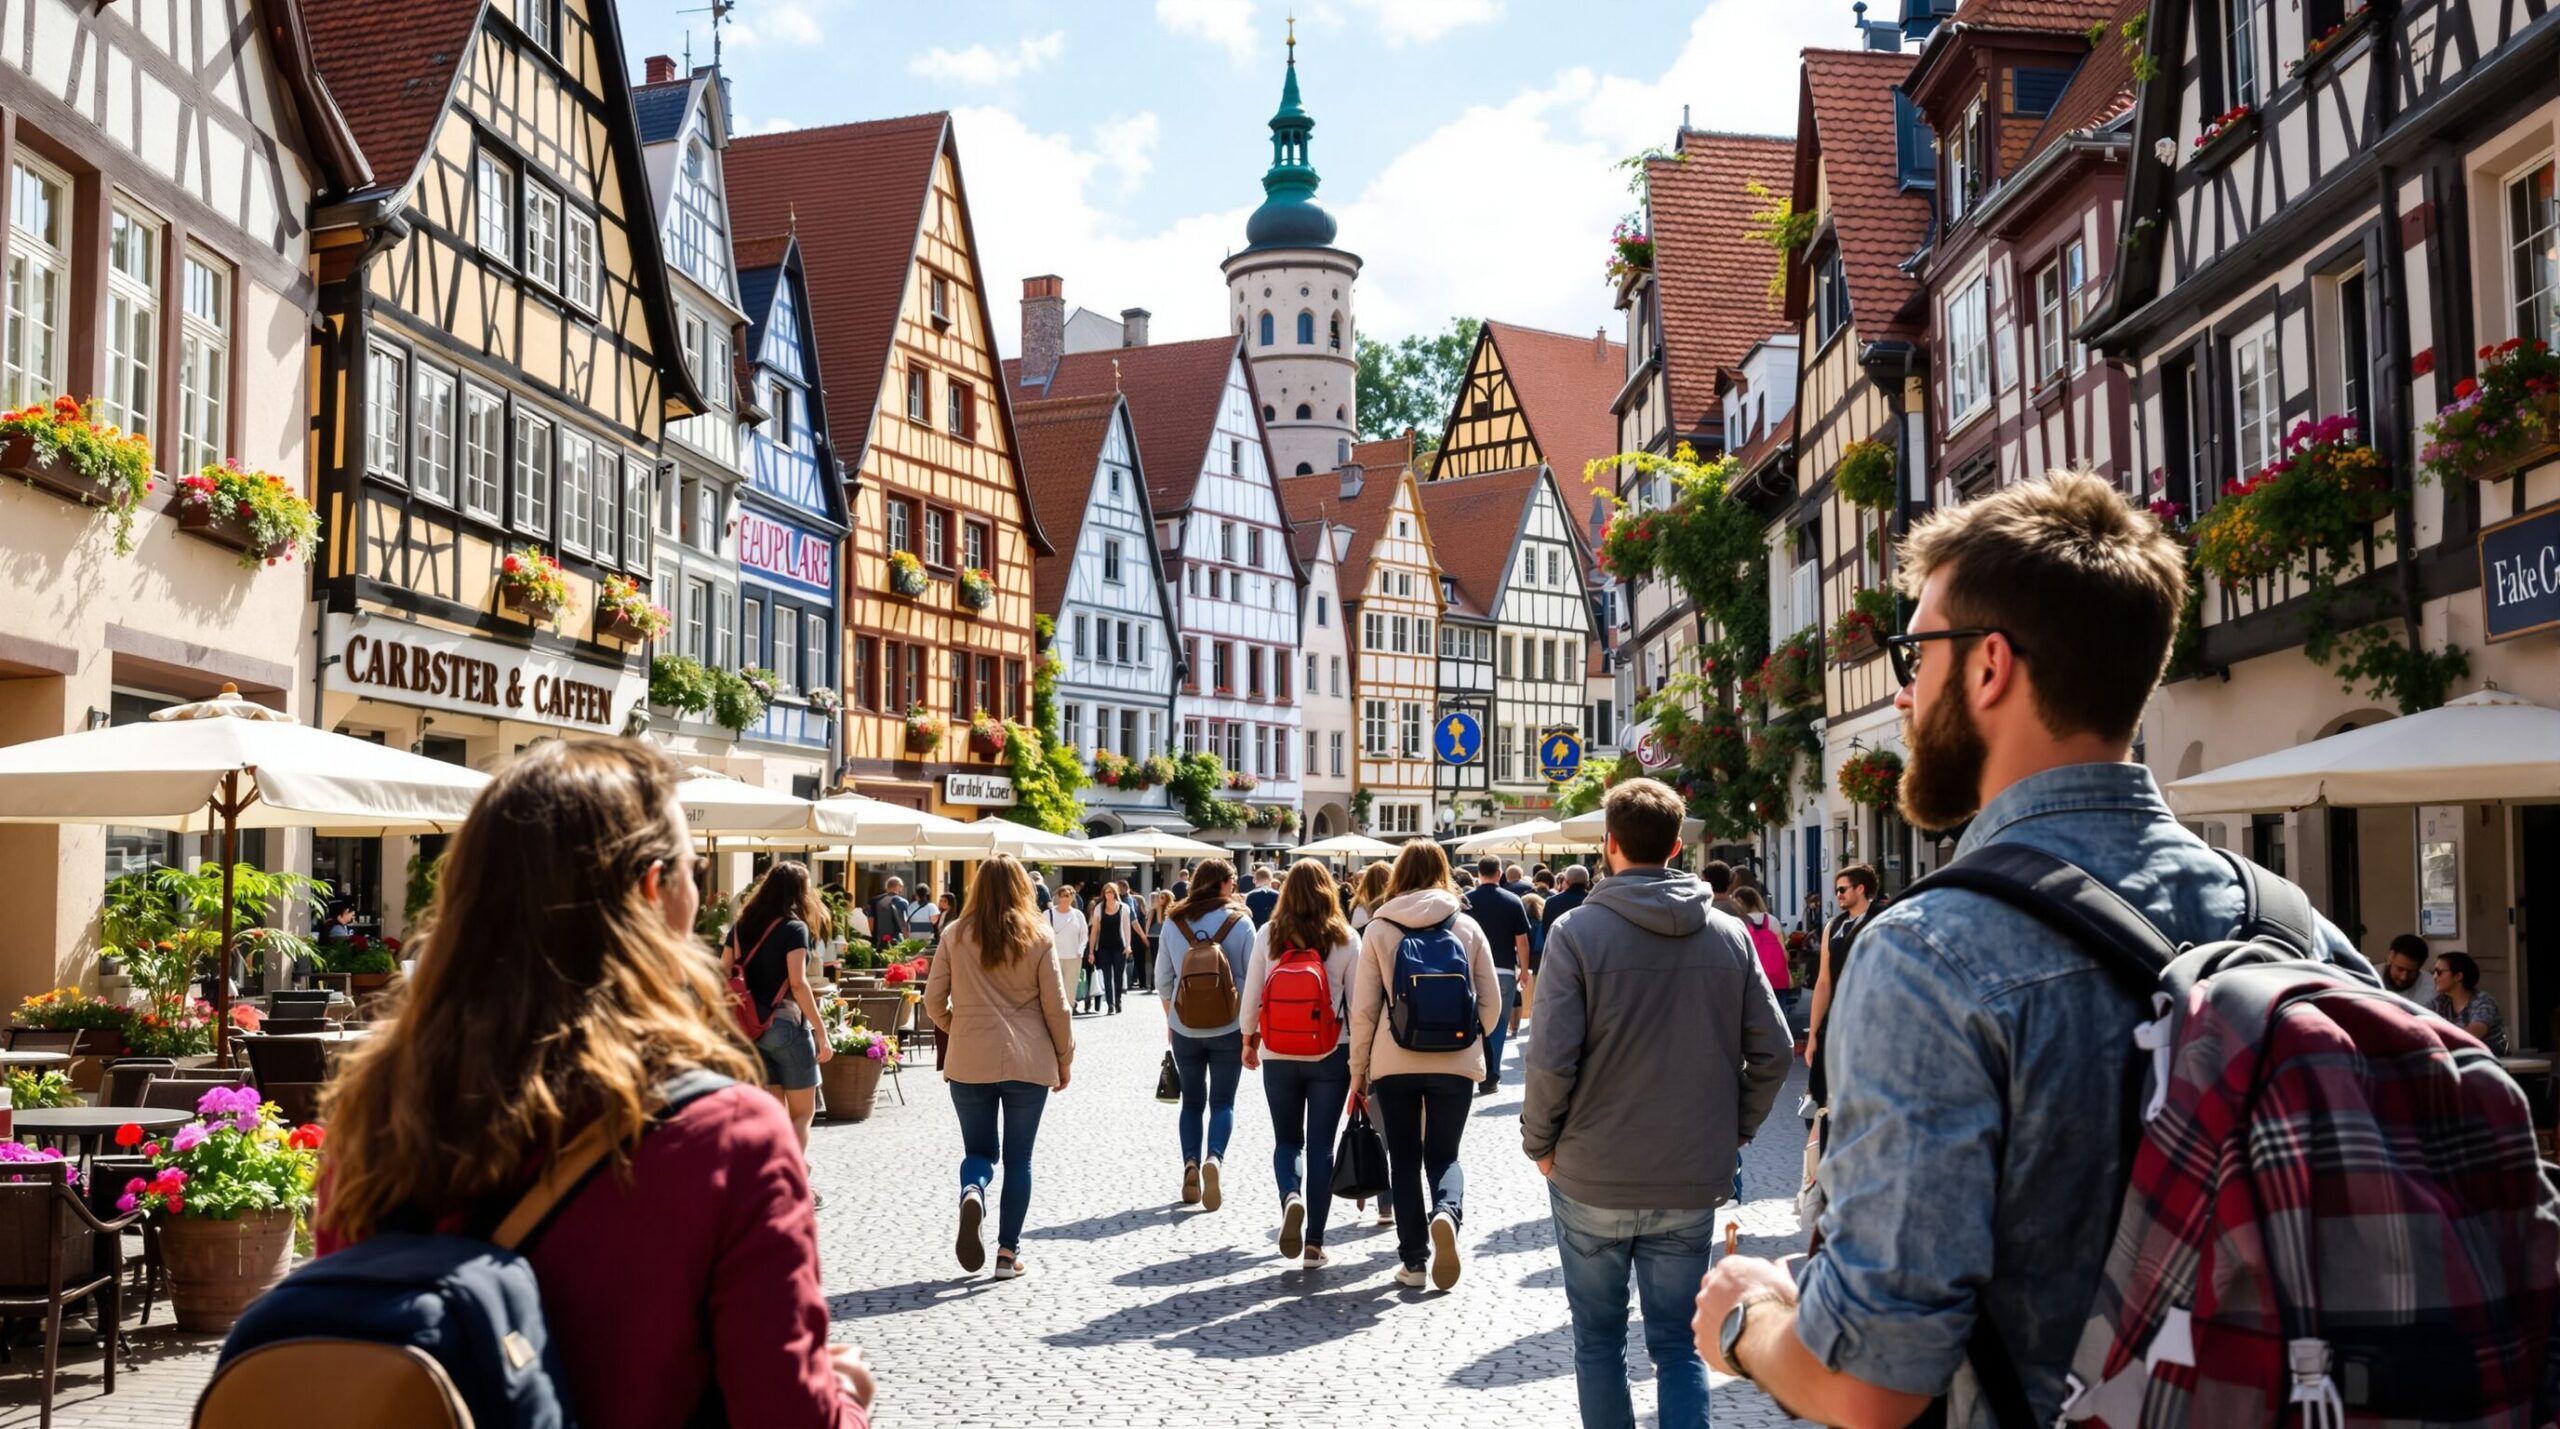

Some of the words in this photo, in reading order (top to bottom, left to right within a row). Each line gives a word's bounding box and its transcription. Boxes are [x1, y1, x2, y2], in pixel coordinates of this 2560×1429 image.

[2494, 554, 2539, 607] Fake
[345, 634, 499, 707] CARBSTER
[505, 667, 524, 709] &
[534, 674, 612, 725] CAFFEN
